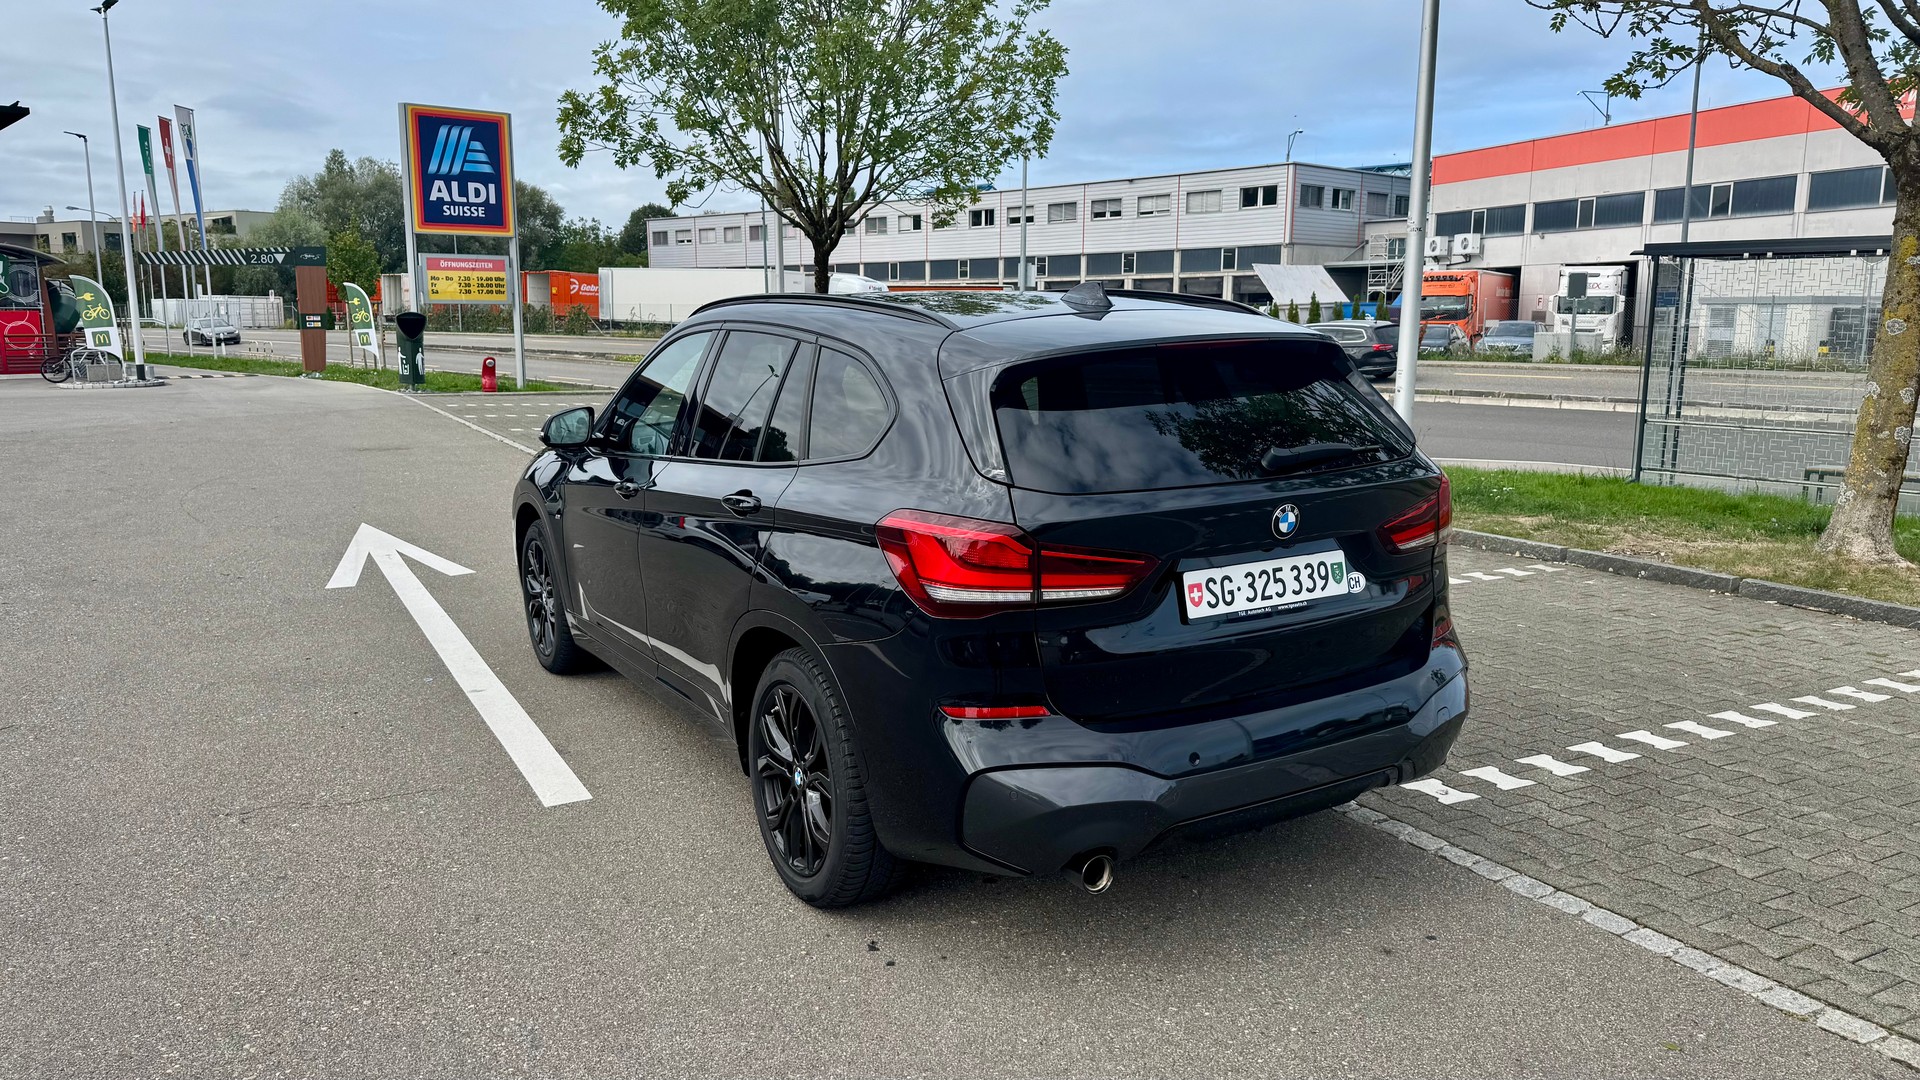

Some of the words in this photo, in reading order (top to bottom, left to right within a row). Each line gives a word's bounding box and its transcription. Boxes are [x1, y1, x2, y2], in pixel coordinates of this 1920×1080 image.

[429, 179, 496, 205] ALDI
[442, 204, 486, 218] SUISSE
[250, 253, 274, 264] 2.80
[440, 259, 493, 269] ÖFFNUNGSZEITEN
[1348, 576, 1361, 590] CH
